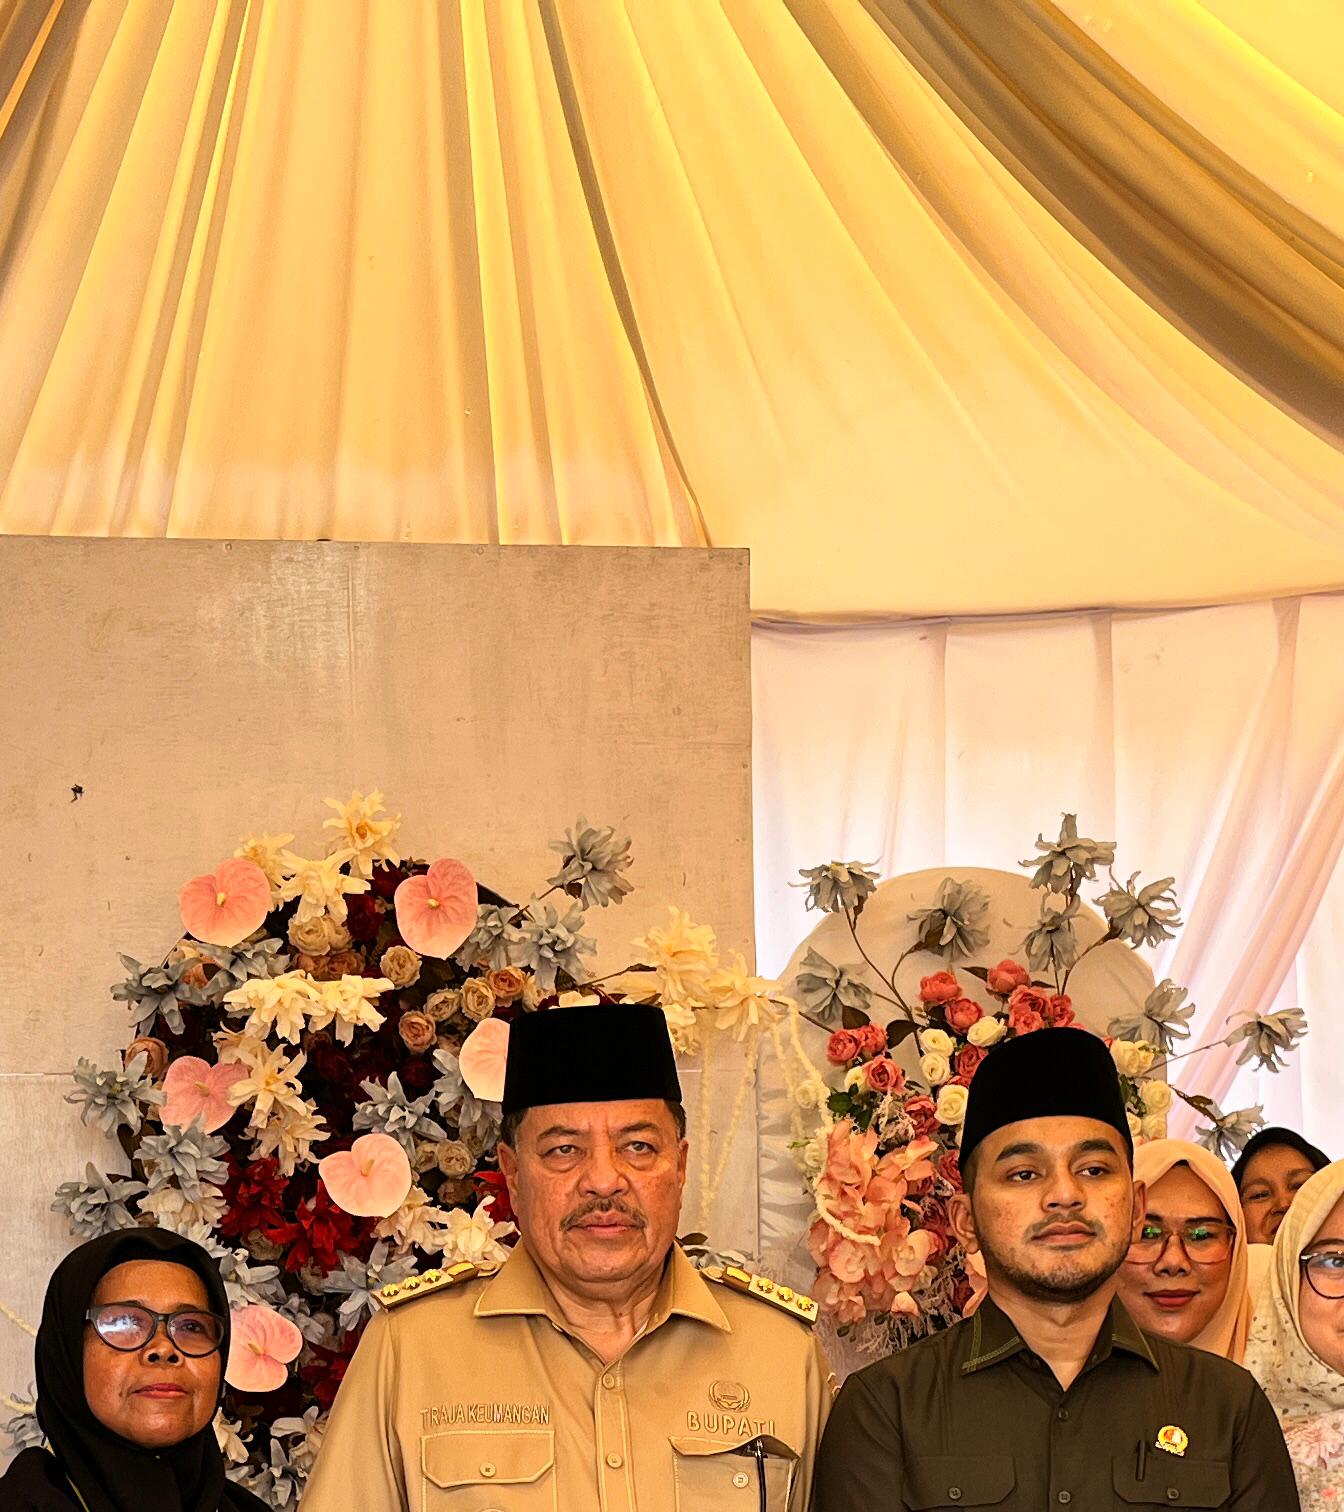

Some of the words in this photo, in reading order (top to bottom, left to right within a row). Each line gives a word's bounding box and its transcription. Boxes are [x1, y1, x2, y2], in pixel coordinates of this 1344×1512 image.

[430, 1405, 465, 1425] RAJA
[467, 1402, 550, 1425] KEUMANGAN
[687, 1410, 776, 1437] BUPATI
